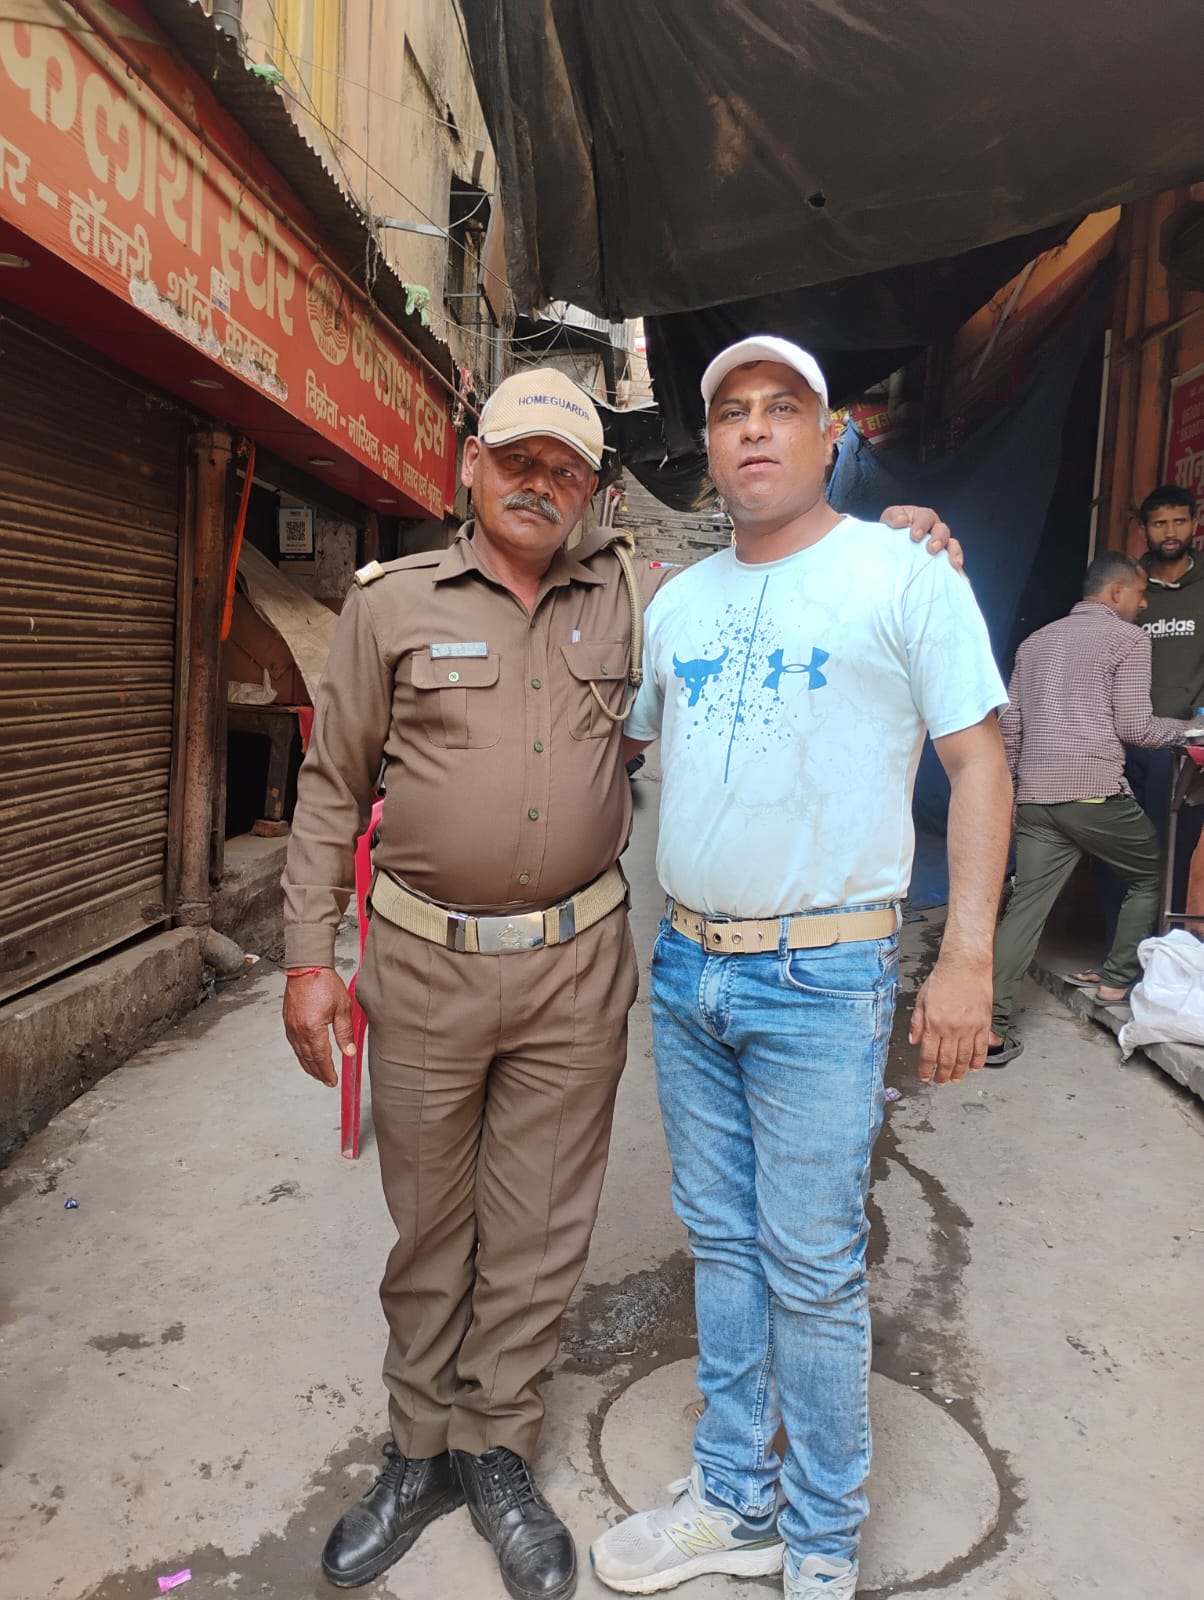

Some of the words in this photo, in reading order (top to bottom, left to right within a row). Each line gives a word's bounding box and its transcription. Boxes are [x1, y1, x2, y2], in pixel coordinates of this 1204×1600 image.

[305, 368, 339, 430] विक्रेता
[518, 395, 590, 421] HOMEGUARDS
[1142, 617, 1196, 634] adidas
